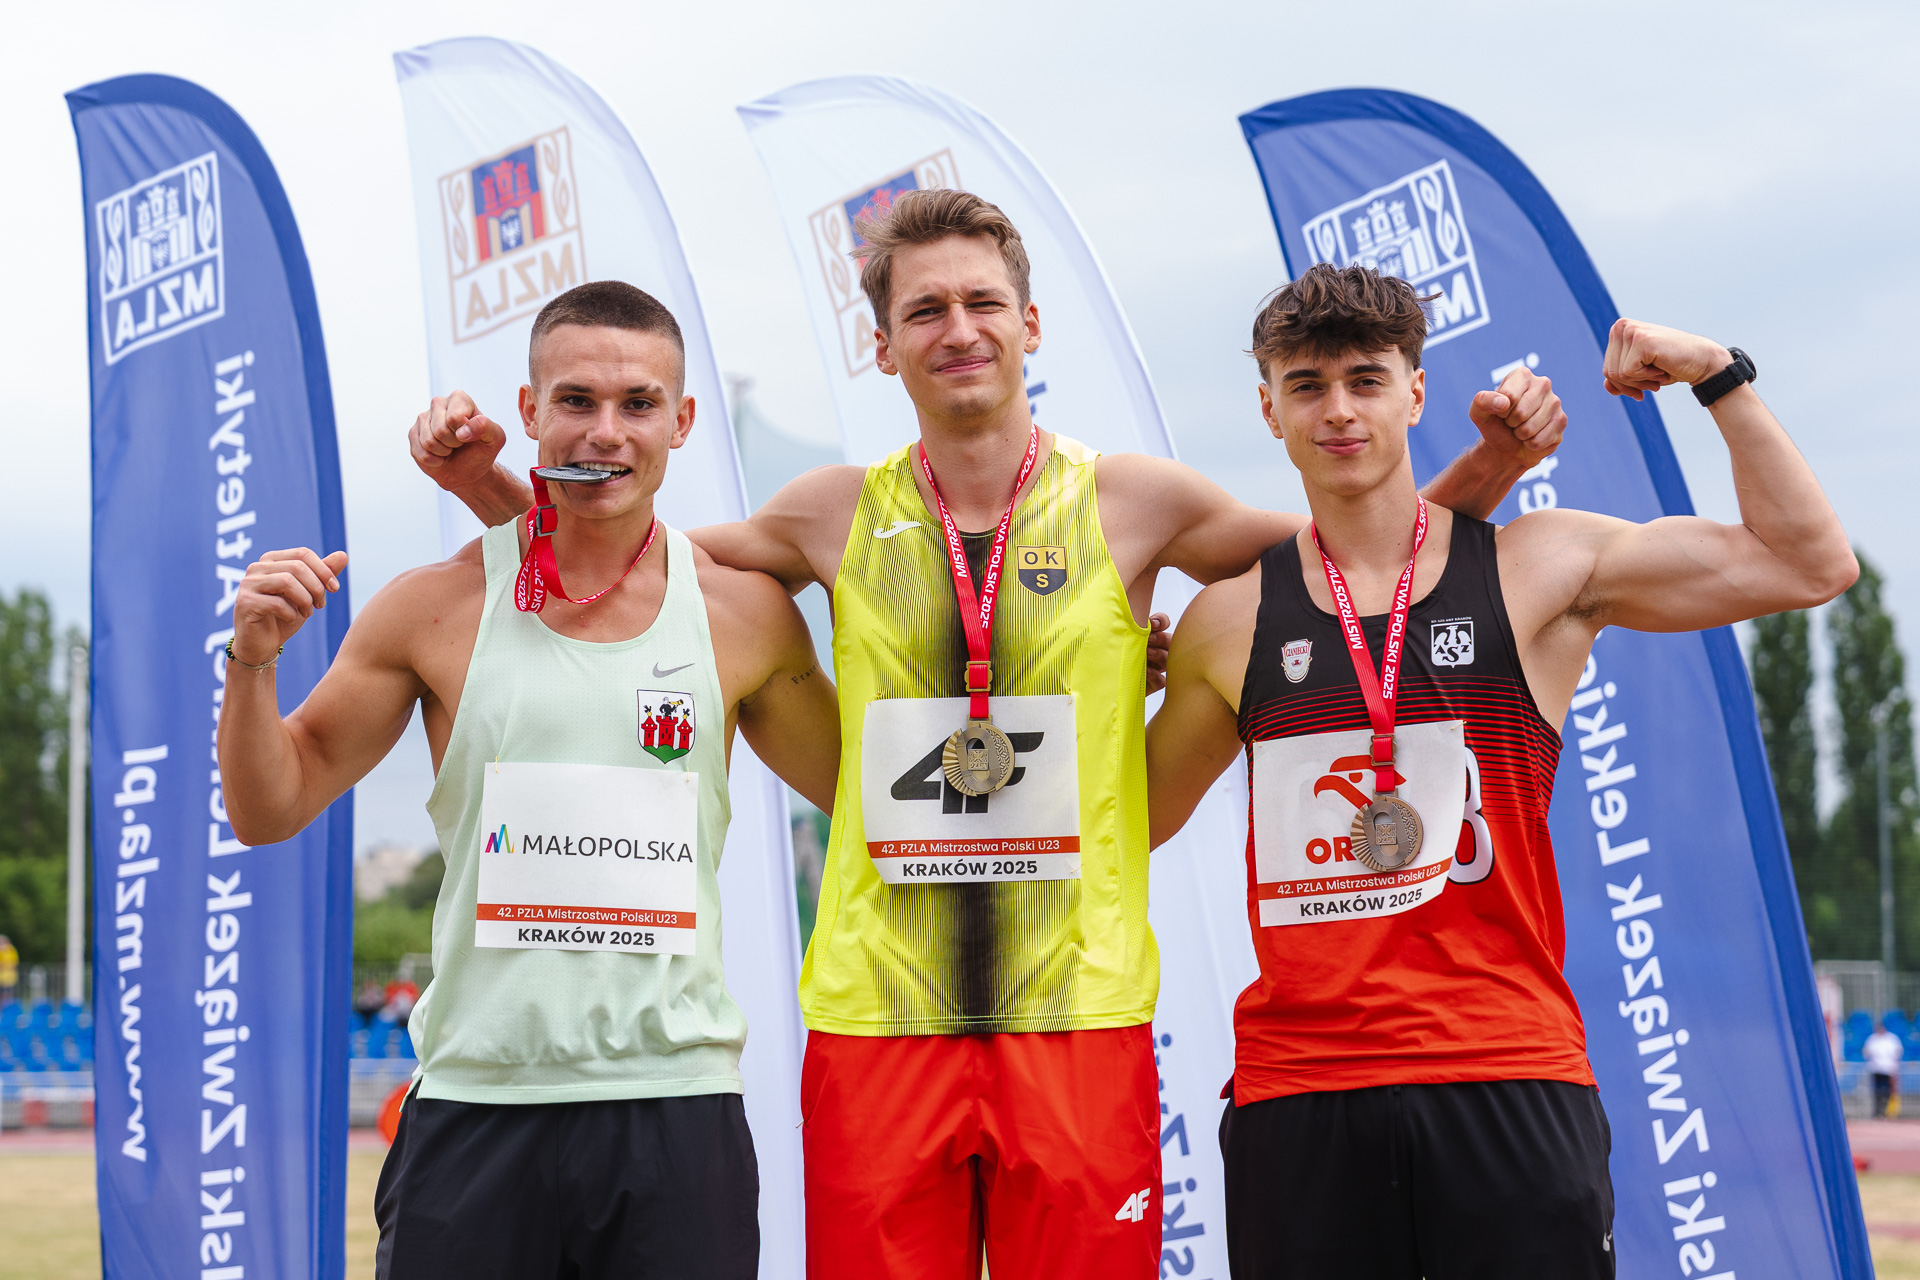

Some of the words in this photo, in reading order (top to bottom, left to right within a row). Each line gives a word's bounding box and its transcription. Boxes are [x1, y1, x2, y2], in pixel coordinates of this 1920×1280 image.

[986, 545, 1003, 594] POLSKI
[980, 596, 993, 629] 2025
[1386, 613, 1404, 663] POLSKI
[1383, 664, 1396, 700] 2025
[522, 834, 693, 863] MAŁOPOLSKA
[881, 844, 898, 854] 42.
[900, 843, 928, 853] PZLA
[930, 842, 999, 853] Mistrzostwa
[1002, 840, 1035, 851] Polski
[1038, 840, 1060, 851] U23
[903, 859, 987, 877] KRAKÓW
[992, 860, 1038, 875] 2025
[1277, 884, 1294, 895] 42.
[1296, 881, 1323, 893] PZLA
[1326, 875, 1395, 891] Mistrzostwa
[1397, 869, 1426, 884] Polski
[1426, 864, 1442, 878] U23
[497, 907, 514, 918] 42.
[517, 908, 544, 918] PZLA
[547, 908, 617, 921] Mistrzostwa
[620, 911, 653, 923] Polski
[656, 914, 678, 924] U23
[1300, 894, 1385, 917] KRAKÓW
[1389, 888, 1423, 908] 2025
[518, 926, 606, 944] KRAKÓW
[609, 931, 655, 946] 2025
[1115, 1187, 1150, 1223] 4F
